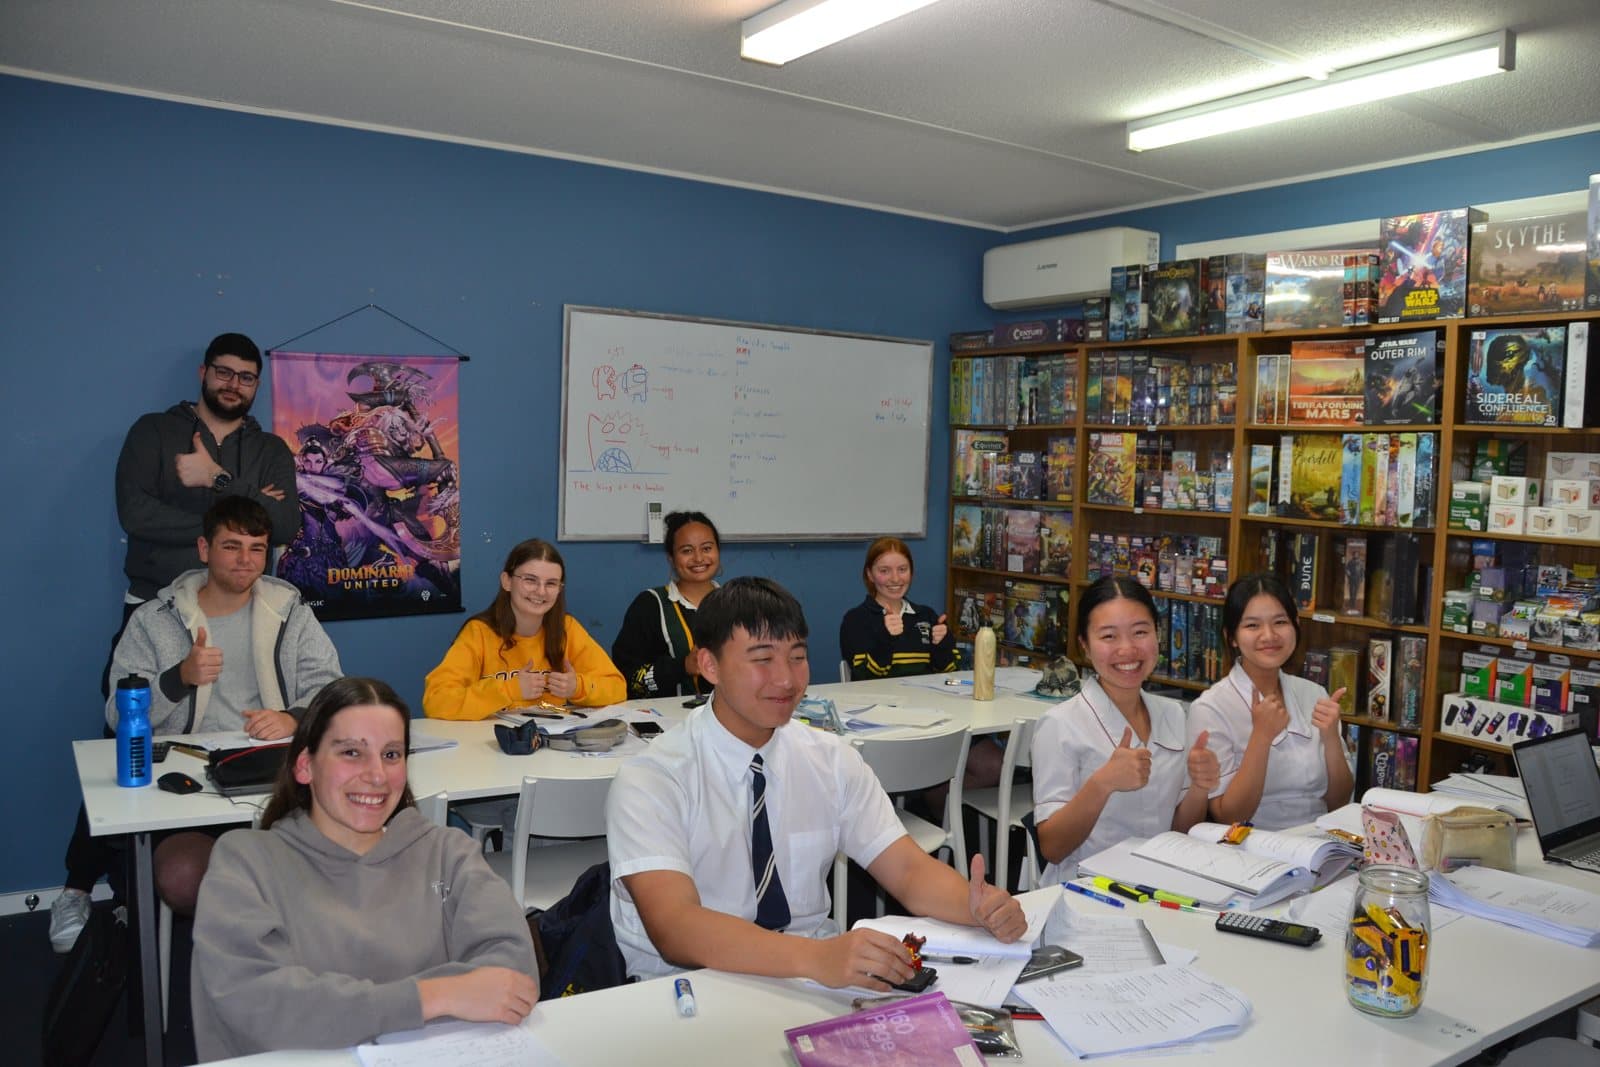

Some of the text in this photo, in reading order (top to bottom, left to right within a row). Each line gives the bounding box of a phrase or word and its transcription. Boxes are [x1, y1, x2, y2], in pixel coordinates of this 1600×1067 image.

[1495, 223, 1567, 254] SCYTHE
[1280, 253, 1319, 269] WAR
[1379, 338, 1418, 348] STAR WARS
[1371, 347, 1427, 361] OUTER RIM
[1476, 392, 1541, 404] SIDEREAL
[1306, 409, 1350, 419] MARS
[1478, 403, 1548, 413] CONFLUENCE
[1301, 556, 1312, 590] DUNE
[344, 579, 399, 590] UNITED
[130, 736, 145, 778] PUMA
